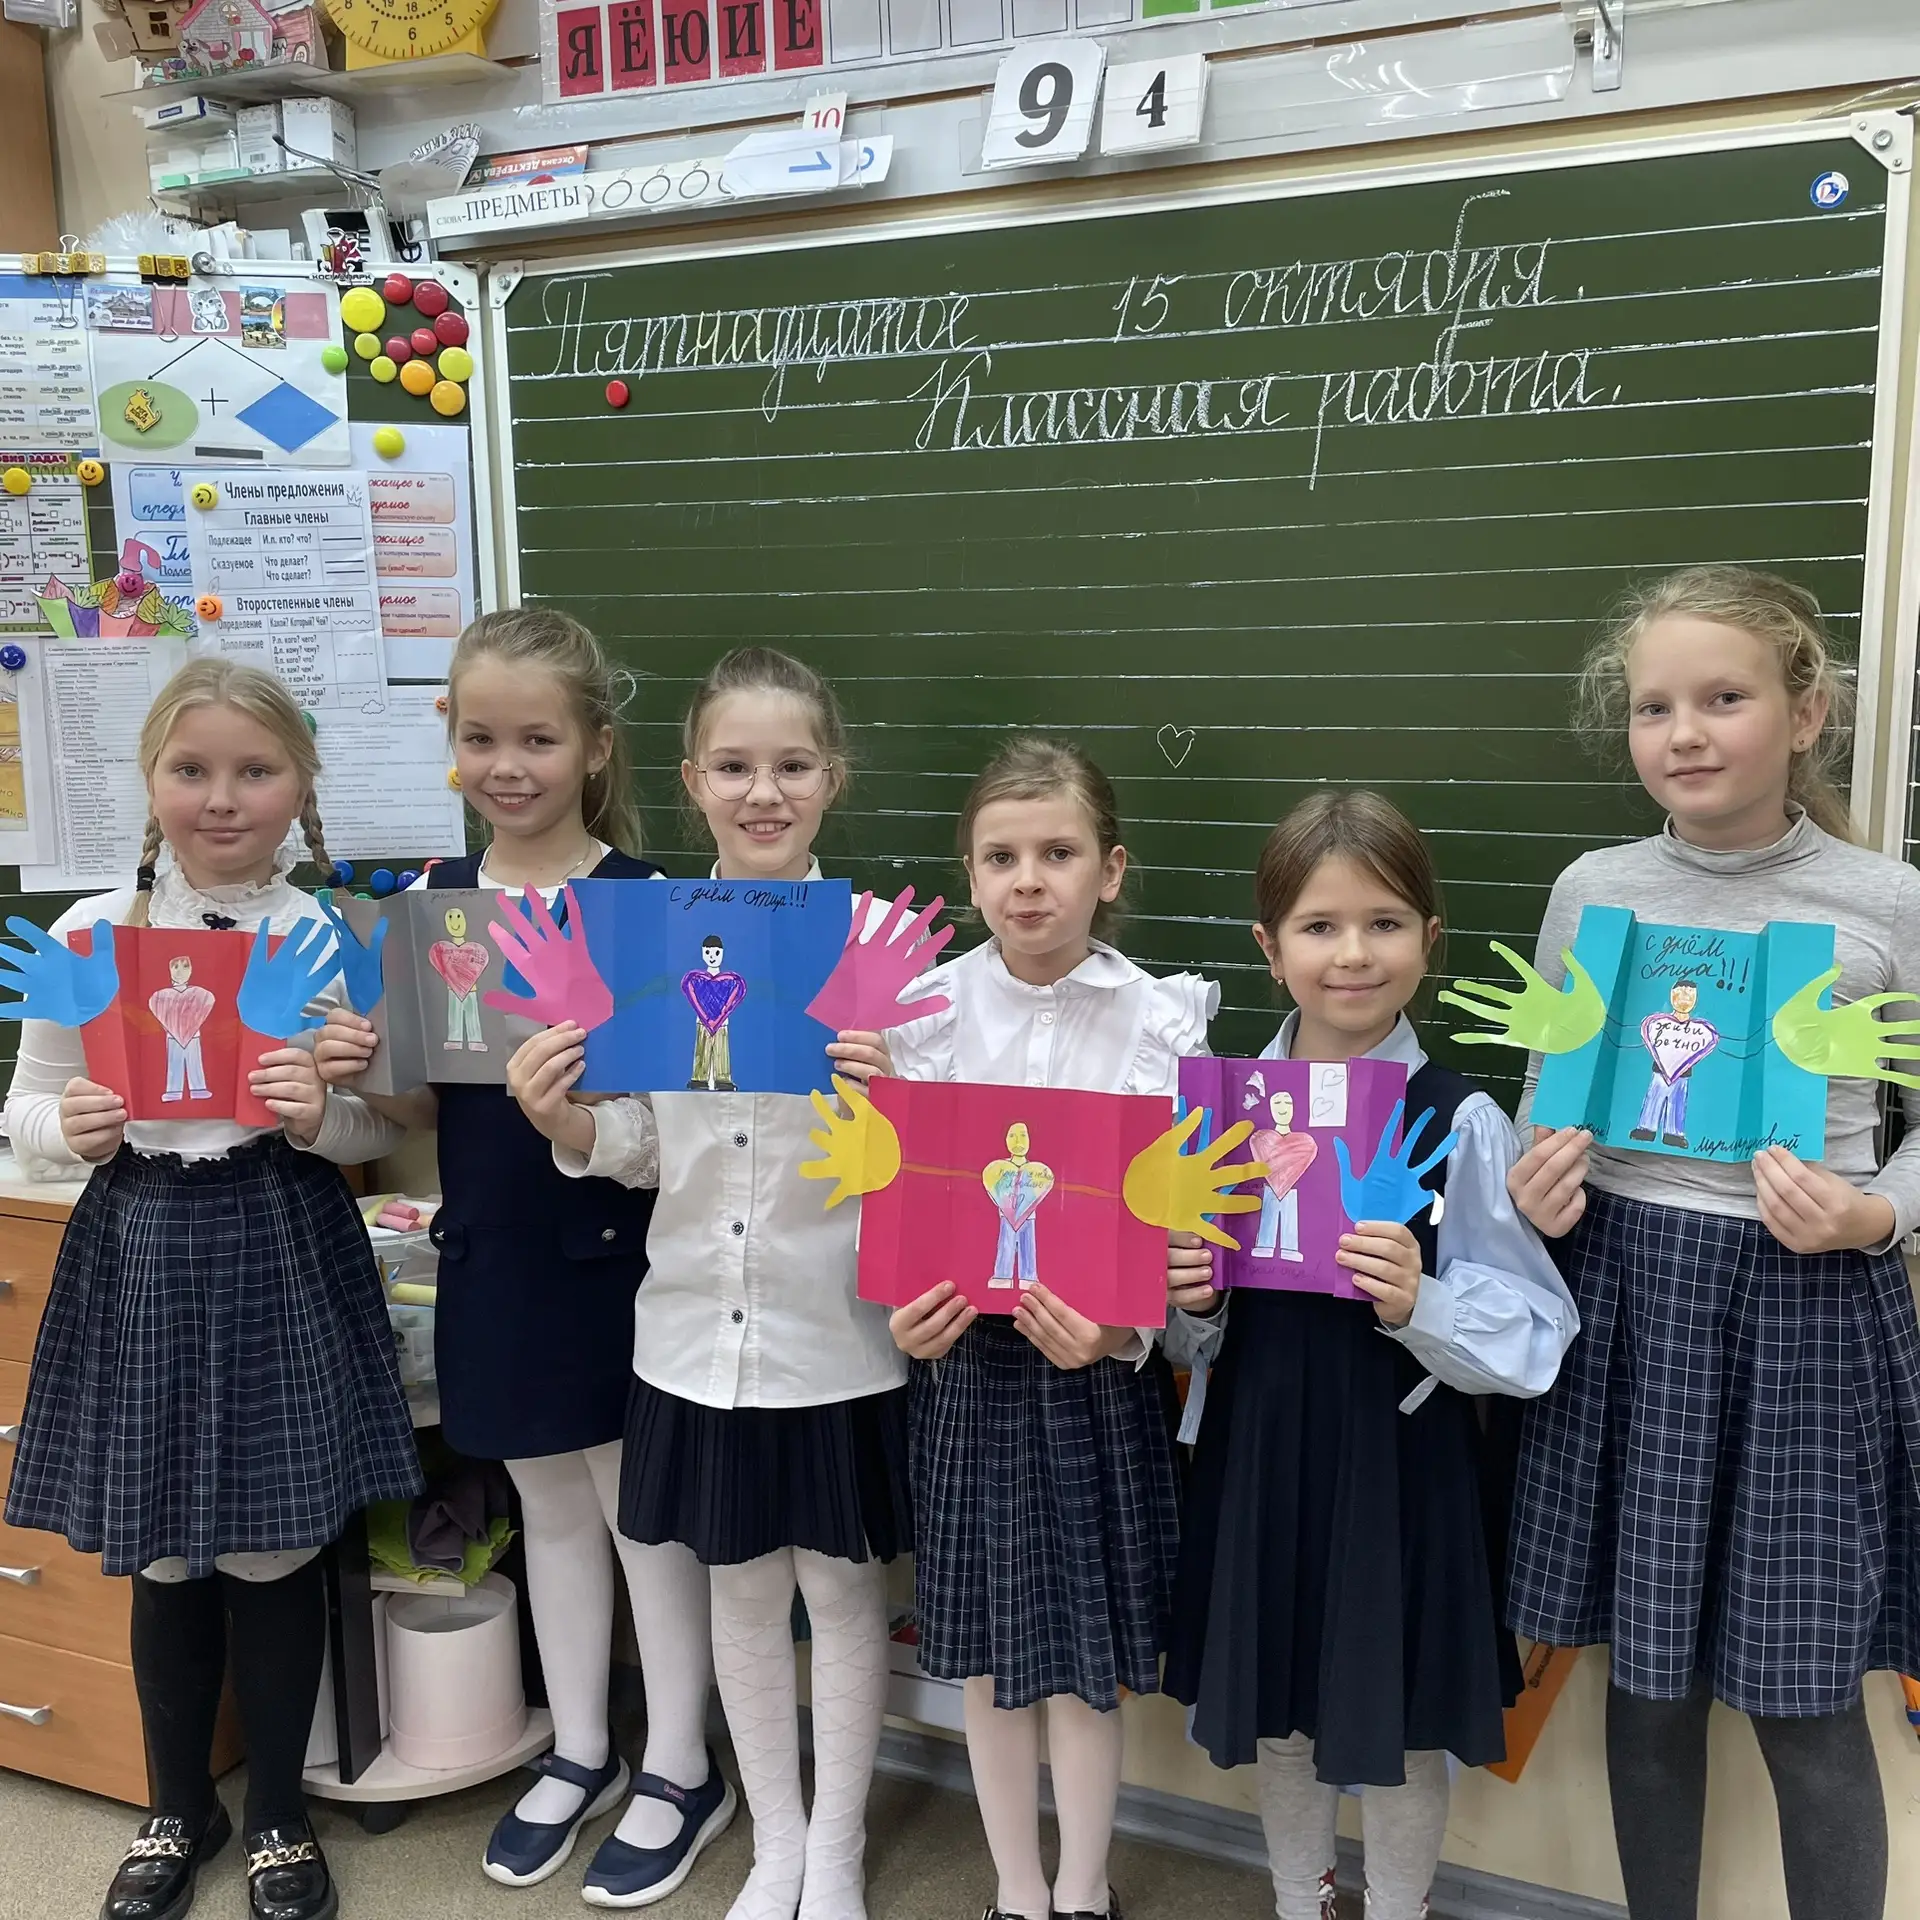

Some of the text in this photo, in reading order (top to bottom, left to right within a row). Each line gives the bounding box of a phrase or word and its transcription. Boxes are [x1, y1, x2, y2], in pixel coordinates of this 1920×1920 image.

[406, 2, 418, 13] 18
[445, 13, 453, 26] 5
[371, 21, 379, 33] 7
[408, 27, 417, 40] 6
[1014, 61, 1074, 148] 9
[1136, 70, 1168, 128] 4
[810, 107, 841, 129] 10
[541, 155, 575, 167] Оксана
[542, 271, 979, 423] Пятнадцатое
[1111, 273, 1187, 343] 15
[906, 350, 1292, 451] Классная
[29, 455, 67, 464] ЗАДАЧ
[225, 482, 344, 501] Члены предложения
[244, 511, 329, 525] Главные члены
[208, 534, 252, 547] Подлежащее
[279, 534, 294, 545] кто?
[296, 533, 312, 544] что?
[211, 558, 254, 572] Сказуемое
[265, 555, 308, 567] Что делает?
[266, 569, 311, 582] Что сделает?
[237, 596, 354, 614] Второстепенные члены
[218, 619, 262, 630] Определение
[220, 638, 264, 651] Дополнение
[684, 882, 736, 911] днём
[1655, 934, 1725, 963] днём
